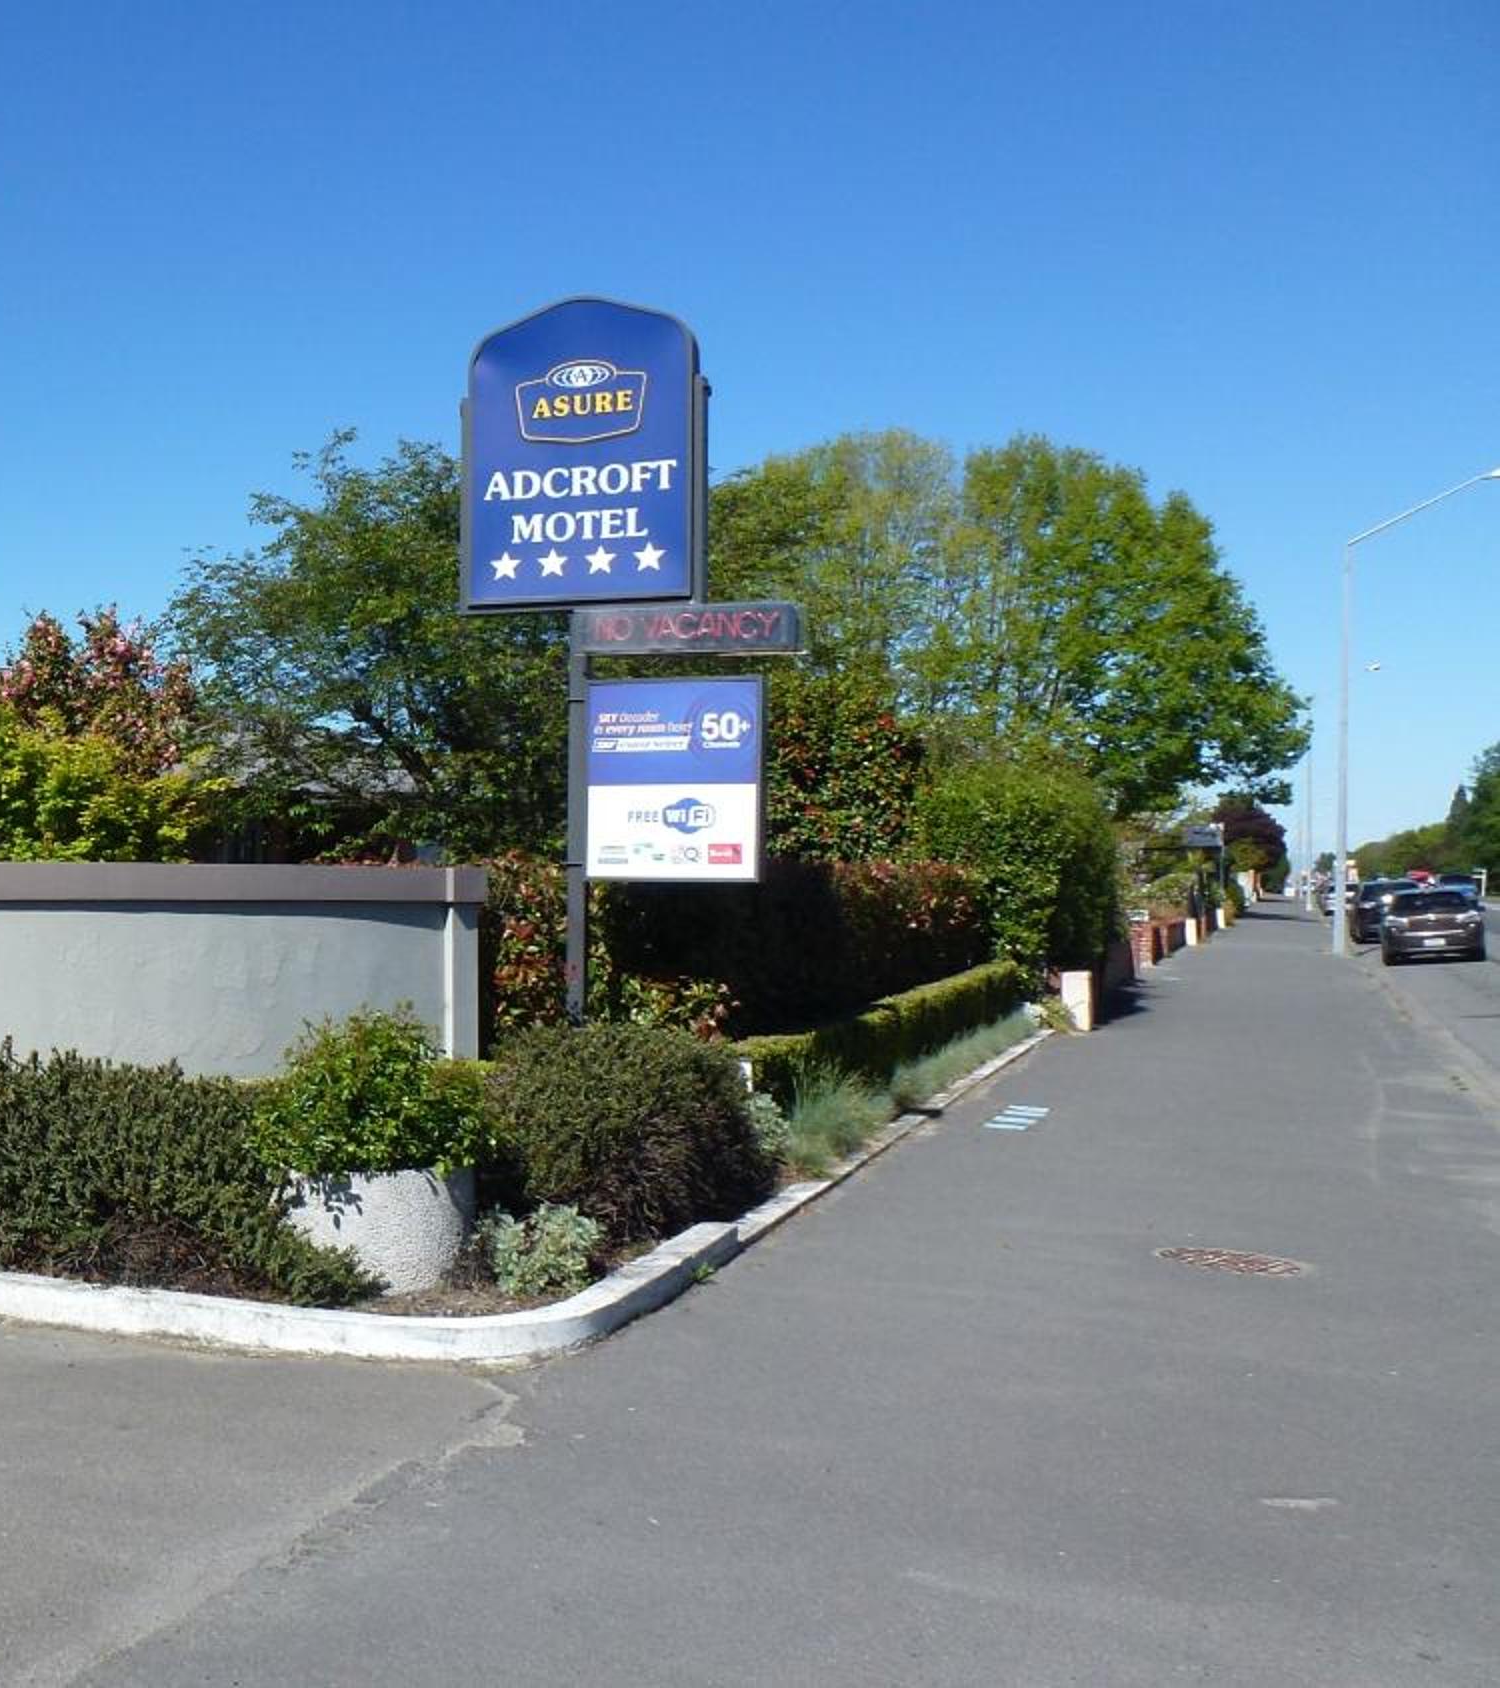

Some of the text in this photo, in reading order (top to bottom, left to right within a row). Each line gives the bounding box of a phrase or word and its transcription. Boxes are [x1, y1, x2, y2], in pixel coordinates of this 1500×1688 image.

[531, 389, 635, 420] ASURE
[484, 459, 677, 502] ADCROFT
[511, 508, 648, 544] MOTEL
[595, 610, 779, 641] NO VACANCY
[702, 712, 751, 741] 50+
[627, 810, 659, 823] FREE
